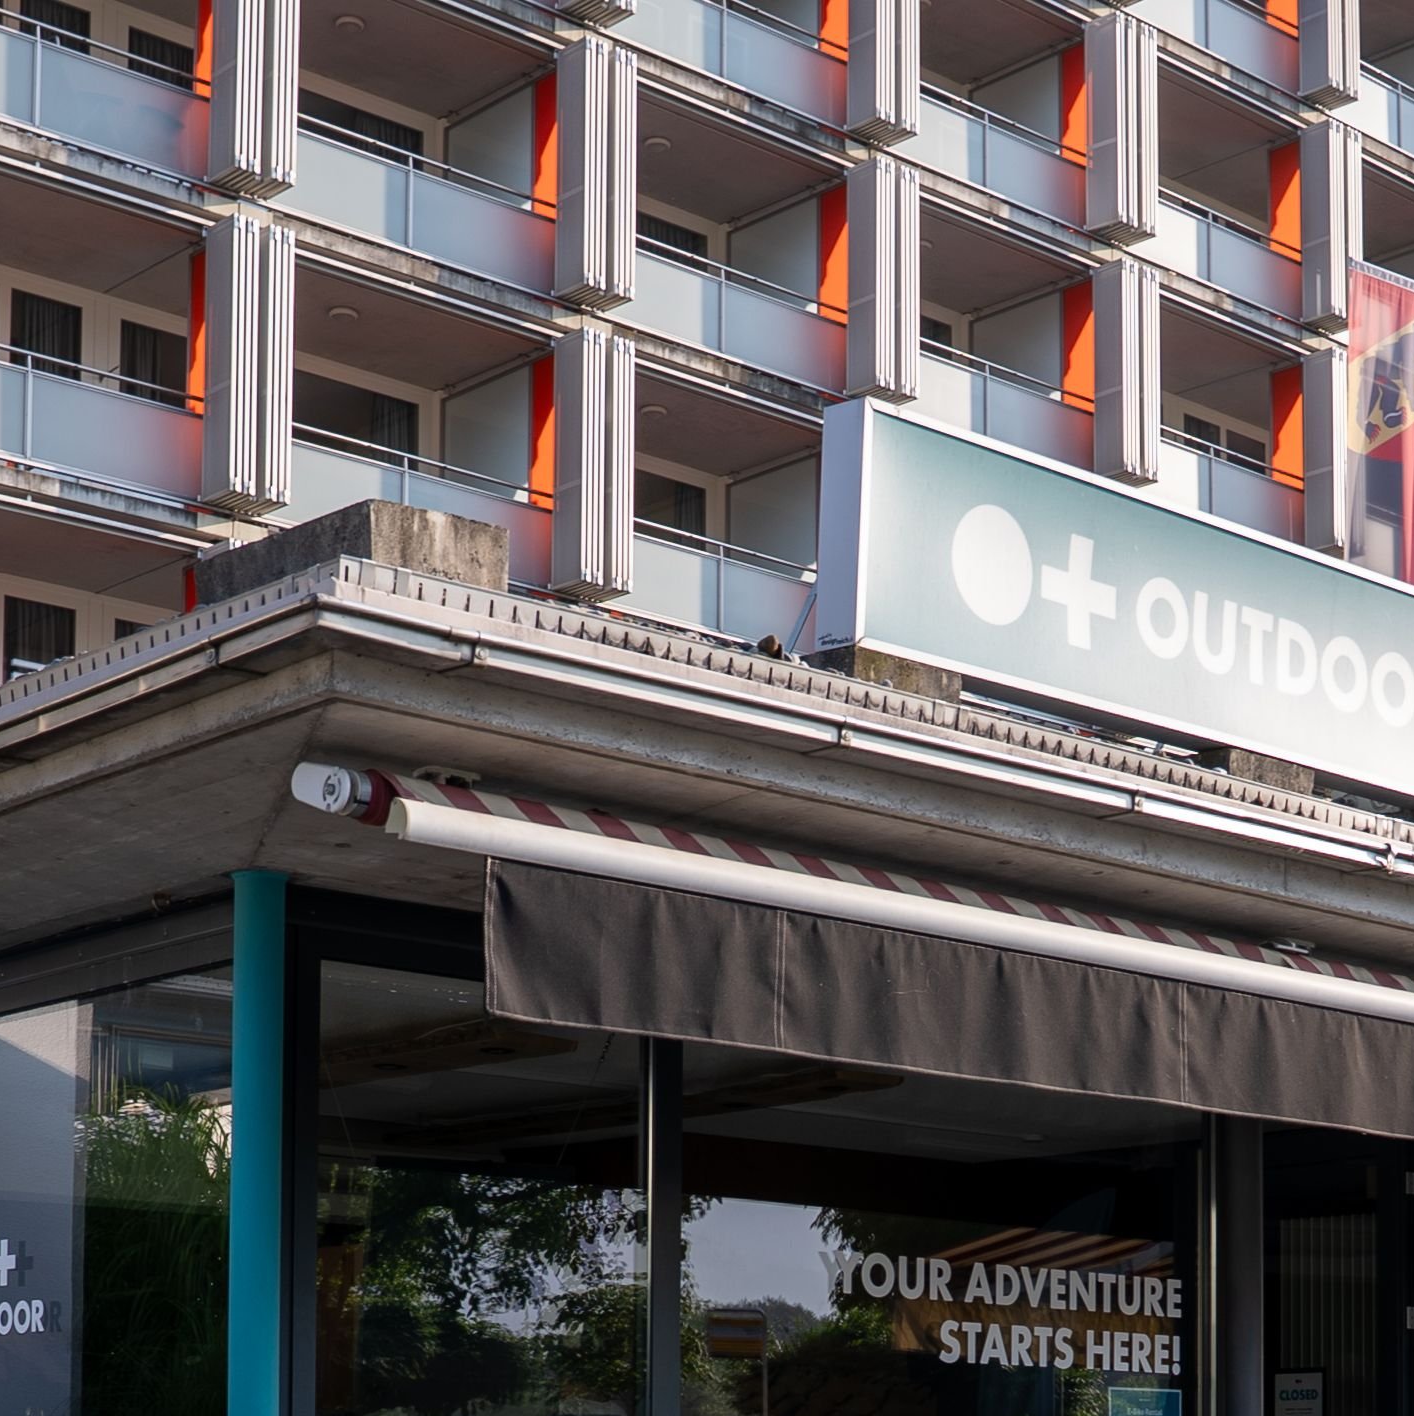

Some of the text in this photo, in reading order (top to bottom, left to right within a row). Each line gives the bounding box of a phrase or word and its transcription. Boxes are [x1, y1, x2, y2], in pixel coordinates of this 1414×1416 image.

[835, 1250, 1183, 1319] YOUR ADVENTURE
[939, 1319, 1182, 1376] STARTS HERE!
[1279, 1389, 1318, 1401] CLOSED
